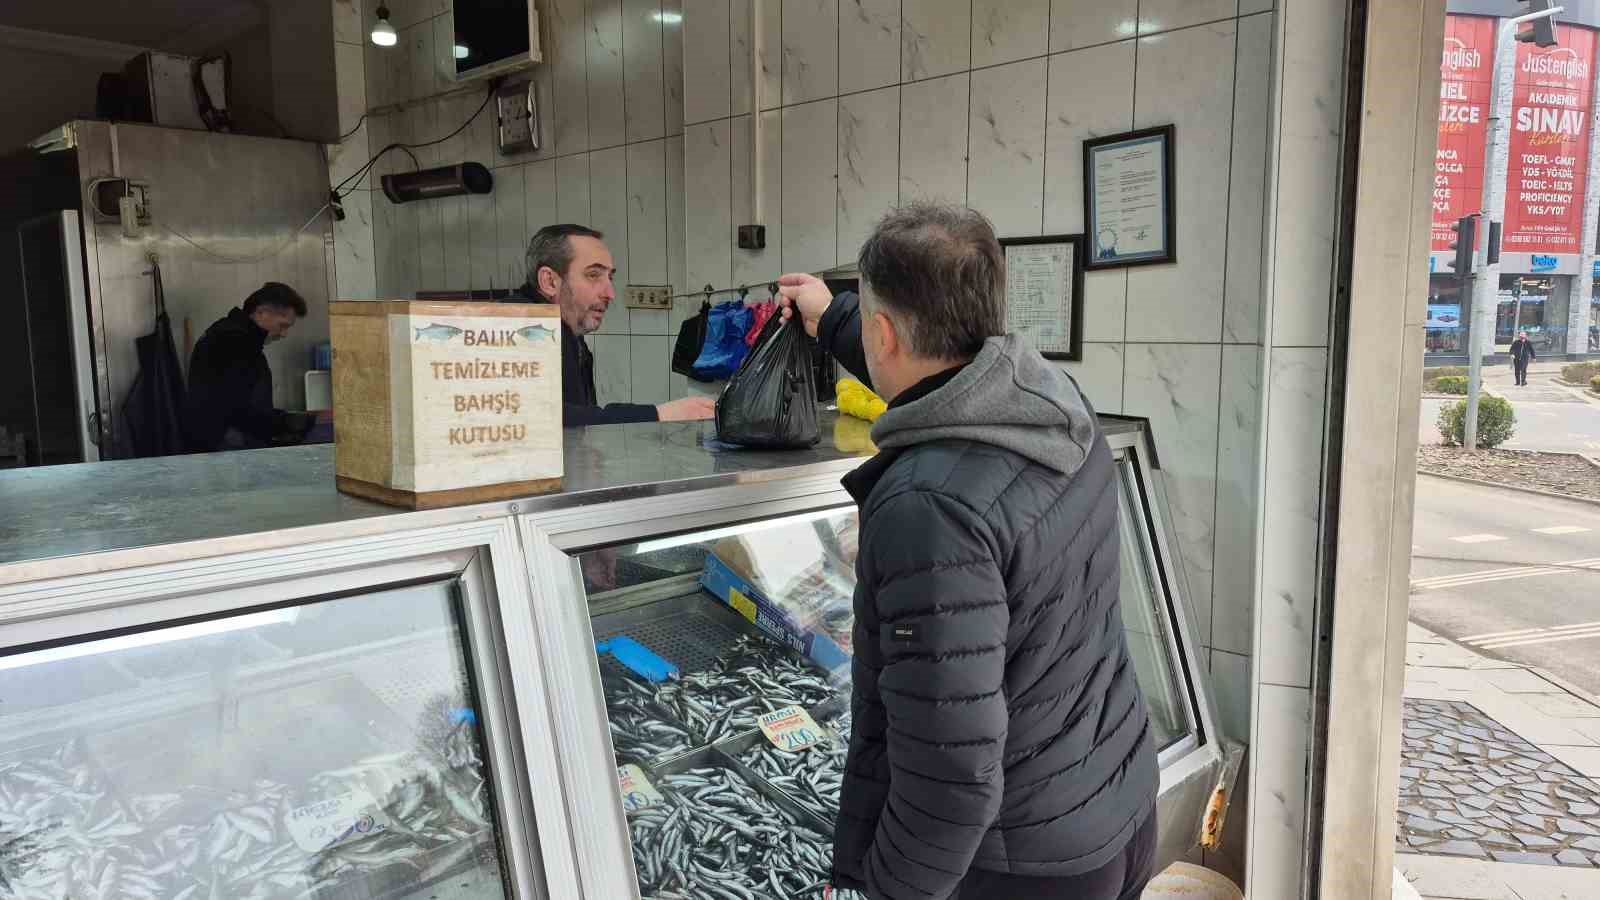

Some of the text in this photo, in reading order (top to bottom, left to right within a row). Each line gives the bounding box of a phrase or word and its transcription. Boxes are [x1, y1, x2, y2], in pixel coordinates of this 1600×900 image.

[1442, 49, 1480, 70] nglish
[1439, 101, 1480, 123] İZCE
[1516, 107, 1584, 136] SINAV
[1521, 154, 1549, 164] TOEFL
[1523, 167, 1540, 177] YDS
[1521, 180, 1547, 189] TOEIC
[1554, 181, 1573, 191] IELTS
[1520, 192, 1573, 204] PROFICIENCY
[463, 329, 517, 347] BALIK
[430, 358, 541, 380] TEMİZLEME
[453, 390, 521, 414] BAHŞİŞ
[449, 424, 527, 446] KUTUSU
